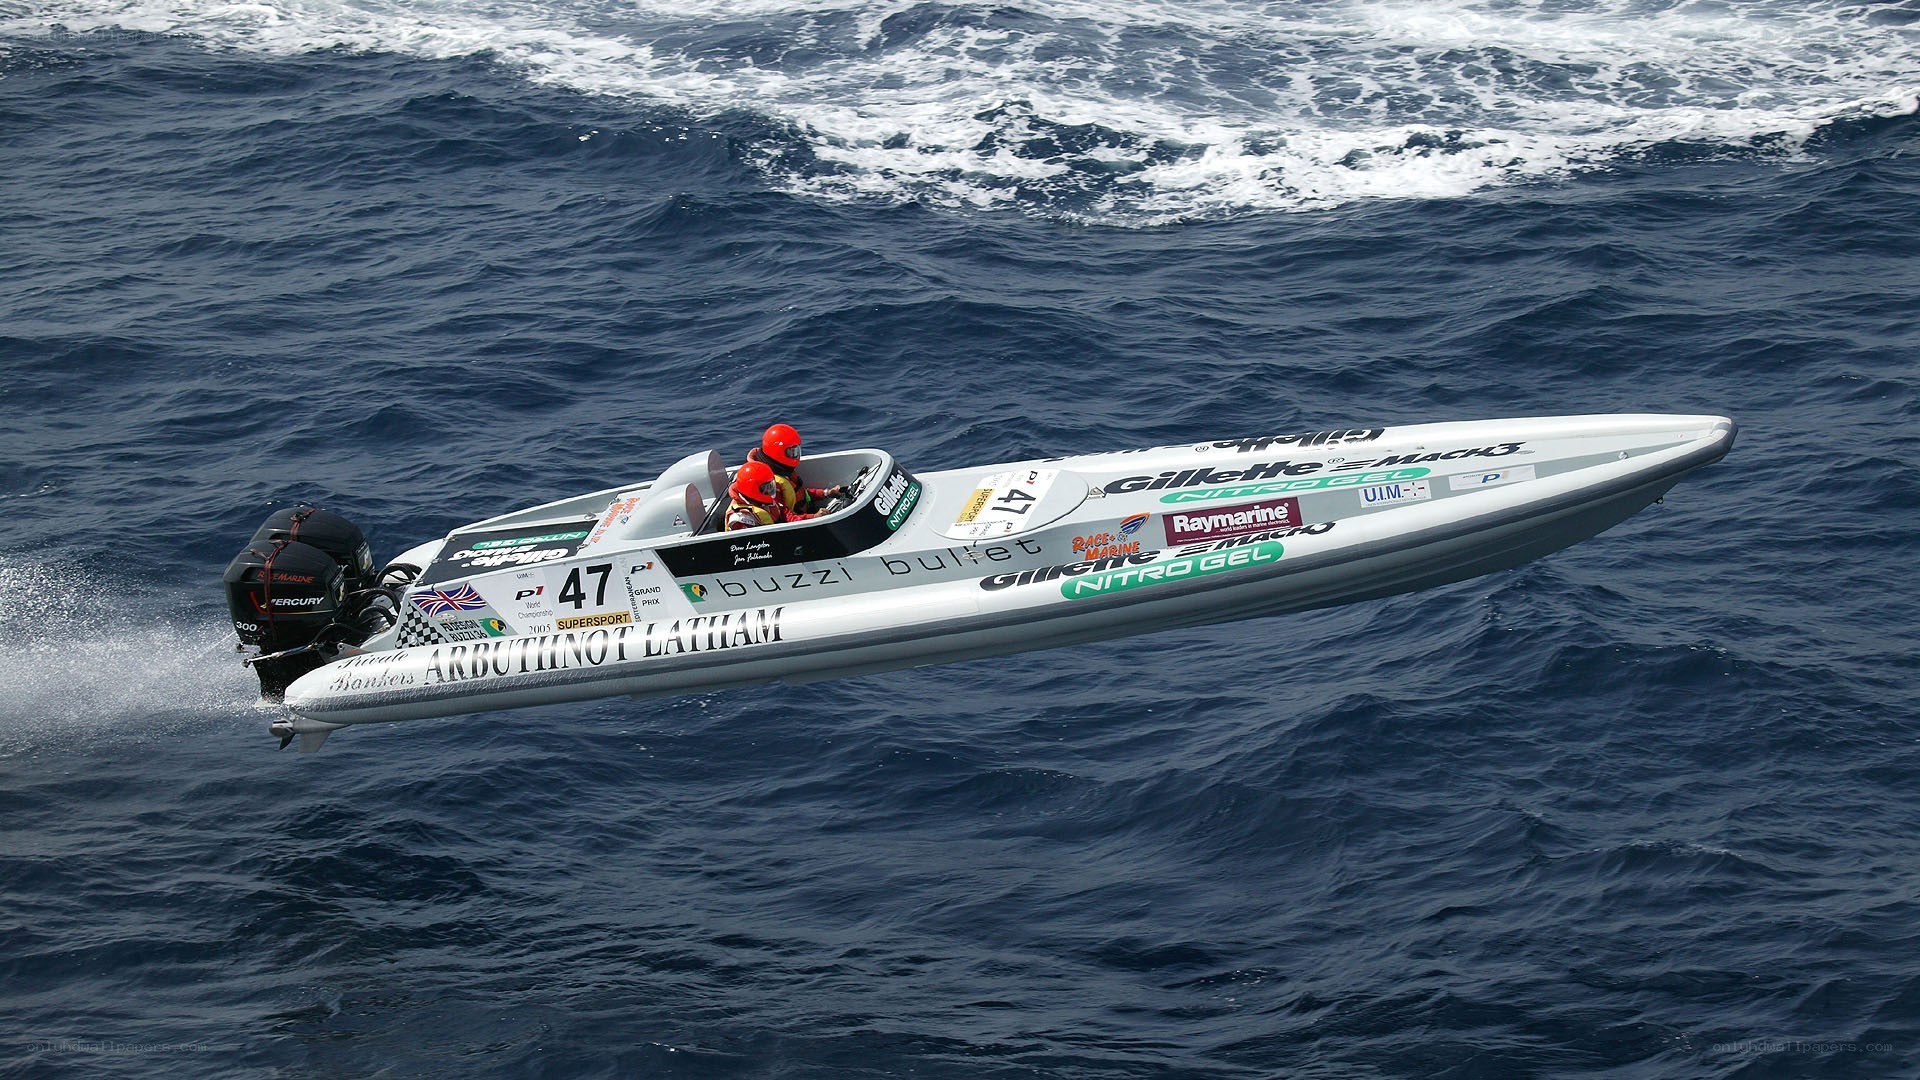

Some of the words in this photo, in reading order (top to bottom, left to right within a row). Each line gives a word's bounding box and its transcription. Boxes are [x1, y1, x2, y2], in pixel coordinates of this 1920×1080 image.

[1103, 460, 1324, 494] Gillette
[1369, 441, 1527, 468] MACH3
[873, 469, 909, 516] Gillette
[1176, 481, 1318, 501] NITRO
[1326, 470, 1415, 486] GEL
[889, 497, 911, 527] NITRO
[906, 486, 919, 502] GEL
[991, 488, 1037, 515] 47
[1172, 505, 1289, 533] Raymarine
[471, 548, 569, 568] Gillette
[1084, 540, 1140, 561] MARINE
[716, 561, 853, 598] buzzi
[879, 539, 1043, 575] bullet
[1074, 560, 1193, 594] NITRO
[1200, 546, 1273, 571] GEL
[515, 585, 544, 601] P1
[558, 562, 613, 611] 47
[624, 576, 643, 623] EDITERRANEAN
[634, 586, 661, 596] GRAND
[517, 609, 554, 619] Championship
[525, 601, 541, 609] World
[641, 598, 660, 607] PRIX
[528, 623, 551, 635] 2005
[557, 613, 629, 631] SUPERSPORT
[424, 622, 635, 686] ARBUTHNOT
[643, 606, 785, 659] LATHAM
[329, 667, 414, 692] Bankers
